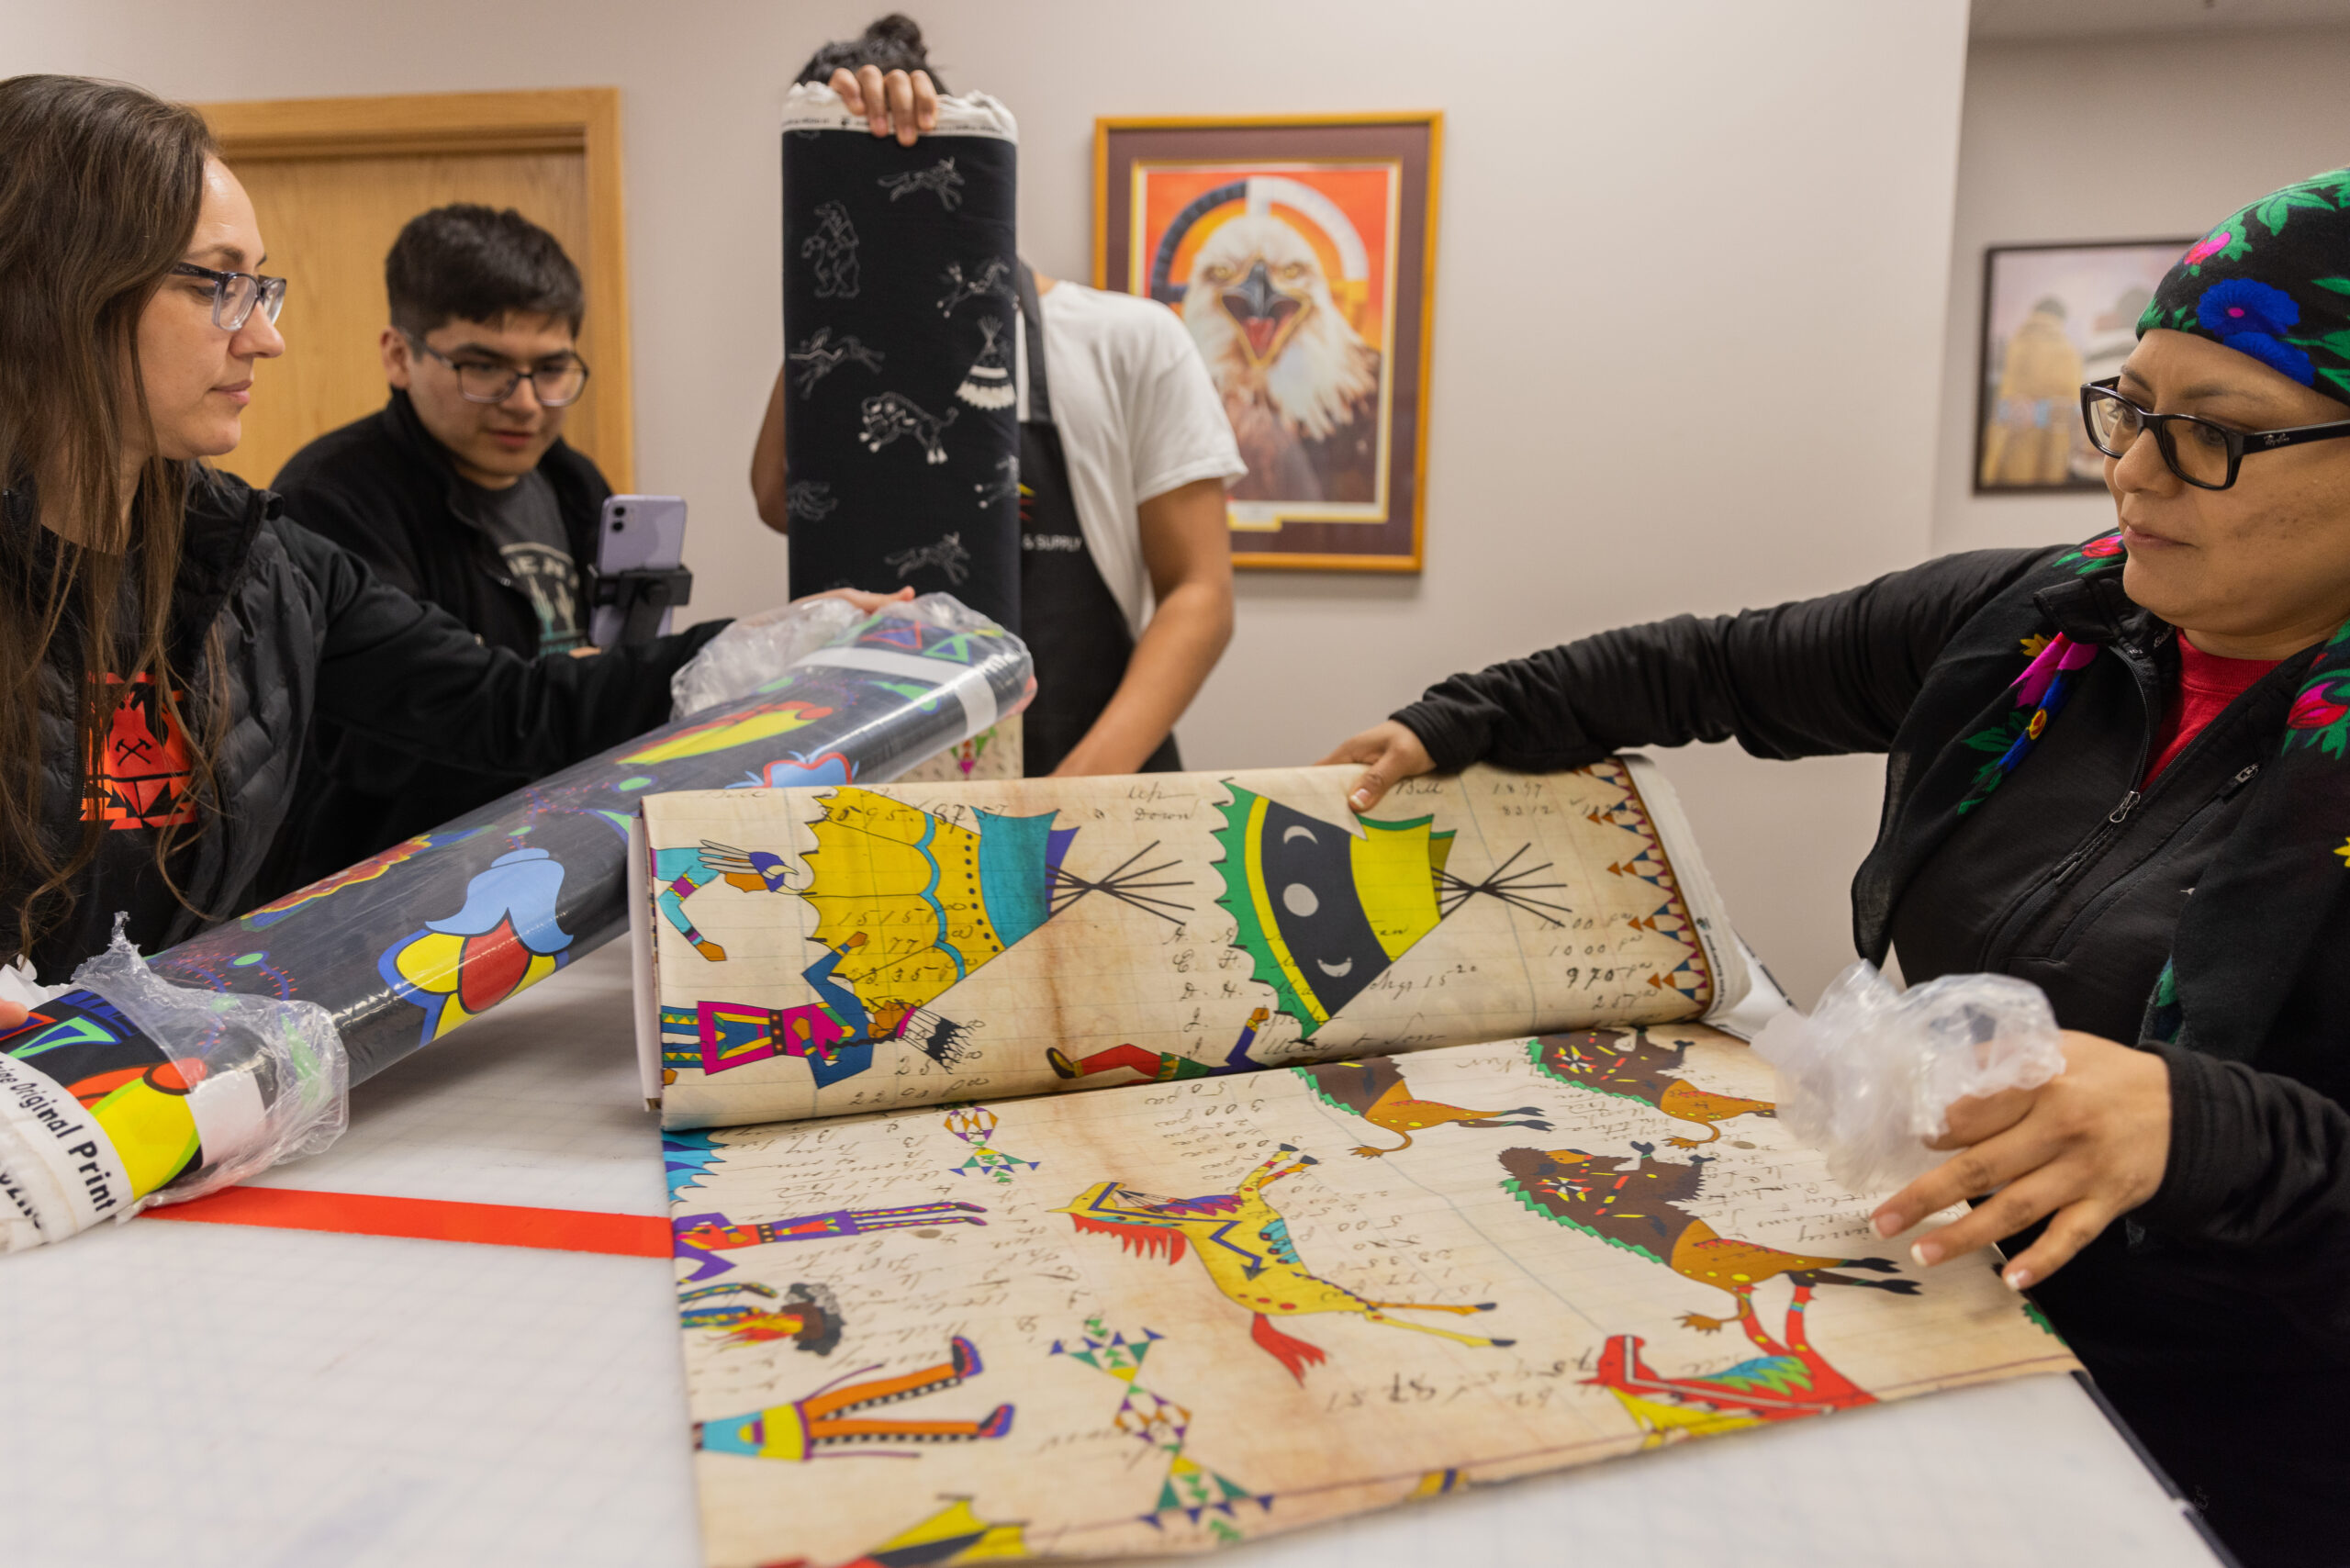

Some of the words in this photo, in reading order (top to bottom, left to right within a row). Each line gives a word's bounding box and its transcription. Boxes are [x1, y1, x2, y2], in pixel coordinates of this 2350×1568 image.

[1035, 534, 1082, 552] SUPPLY
[9, 1081, 85, 1139] Original
[68, 1139, 117, 1213] Print
